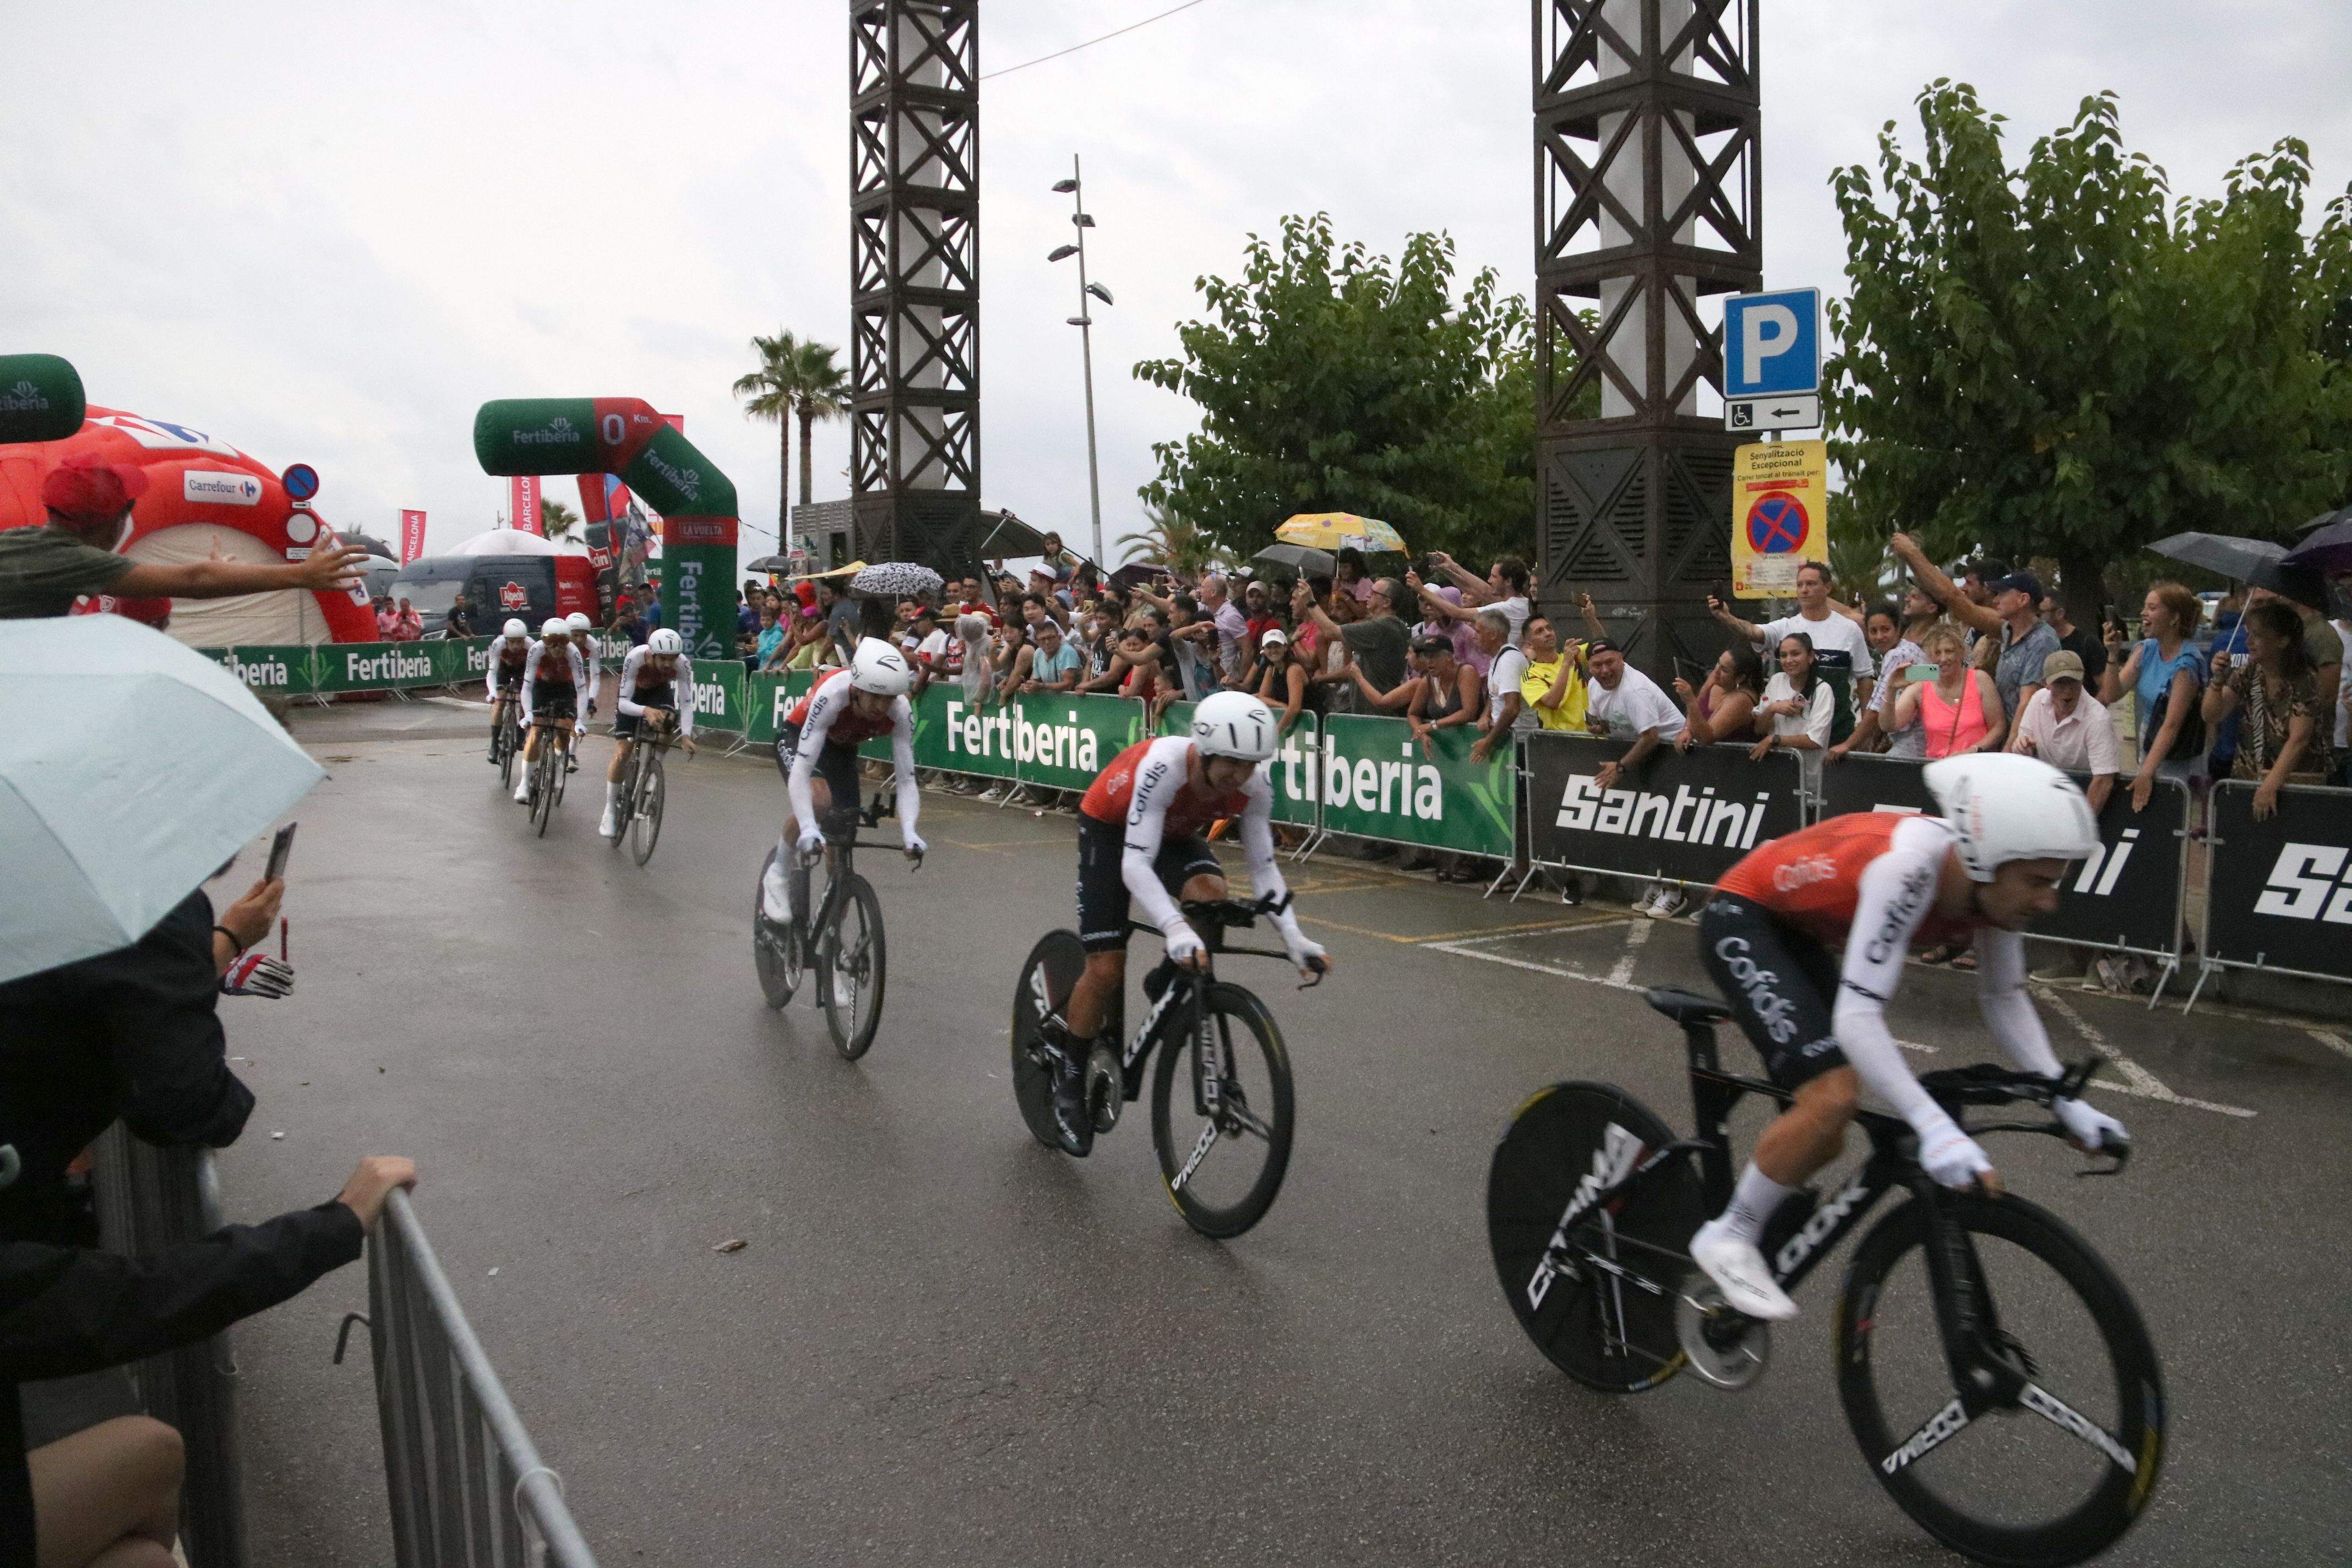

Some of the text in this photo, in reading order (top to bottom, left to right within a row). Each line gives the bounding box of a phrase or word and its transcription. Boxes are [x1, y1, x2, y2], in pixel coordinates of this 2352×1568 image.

[1742, 304, 1799, 384] P
[513, 429, 580, 444] Fertiberia
[602, 414, 625, 445] 0
[643, 448, 698, 502] Fertiberia
[1750, 448, 1804, 460] Senyalització
[1751, 459, 1801, 470] Excepcional
[189, 479, 236, 493] Carrefour
[406, 515, 419, 562] ARCELONA
[678, 561, 704, 659] Fertibe
[347, 650, 431, 682] Fertiberia
[800, 695, 829, 741] Cofidis
[946, 700, 1098, 772] Fertiberia
[1128, 761, 1168, 826] Cofidis
[1555, 774, 1770, 850] Santini
